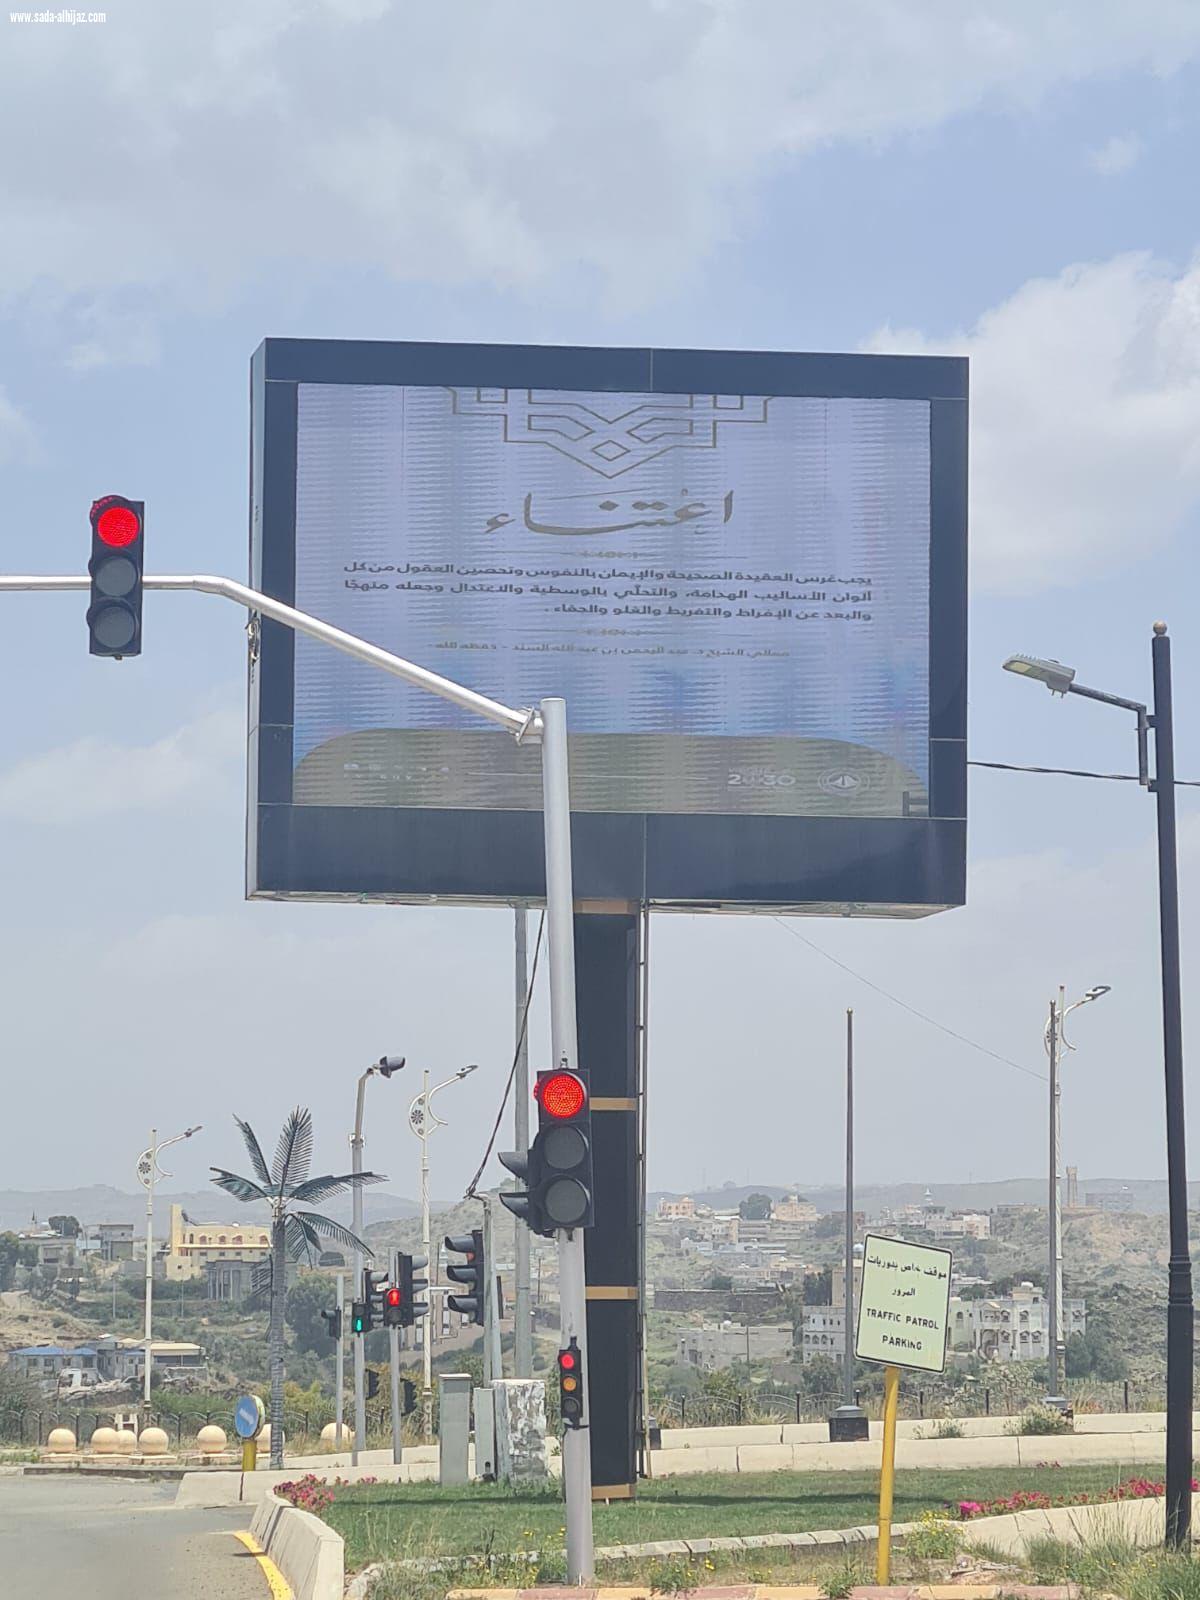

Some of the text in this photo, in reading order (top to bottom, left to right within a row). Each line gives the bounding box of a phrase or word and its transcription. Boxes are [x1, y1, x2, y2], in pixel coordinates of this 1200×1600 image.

[343, 561, 872, 586] يجب غرس العقيدة الصحيحة والإيمان بالنفوس وتحصين العقول من كل
[395, 581, 444, 593] وجعله
[450, 582, 524, 595] والاعتدال
[529, 585, 608, 597] بالوسطية
[753, 590, 826, 601] الأساليب
[832, 590, 872, 603] ألوان
[612, 604, 662, 616] والغلو
[665, 605, 732, 618] والتفريط
[735, 608, 793, 620] الإفراط
[795, 610, 820, 620] عن
[823, 610, 872, 621] والبعد
[727, 773, 797, 786] 230
[867, 1255, 947, 1279] موقف خاص بدوريات
[892, 1287, 915, 1297] المرور
[867, 1308, 940, 1330] TRAFFIC PATROL
[882, 1335, 922, 1350] PARKING
